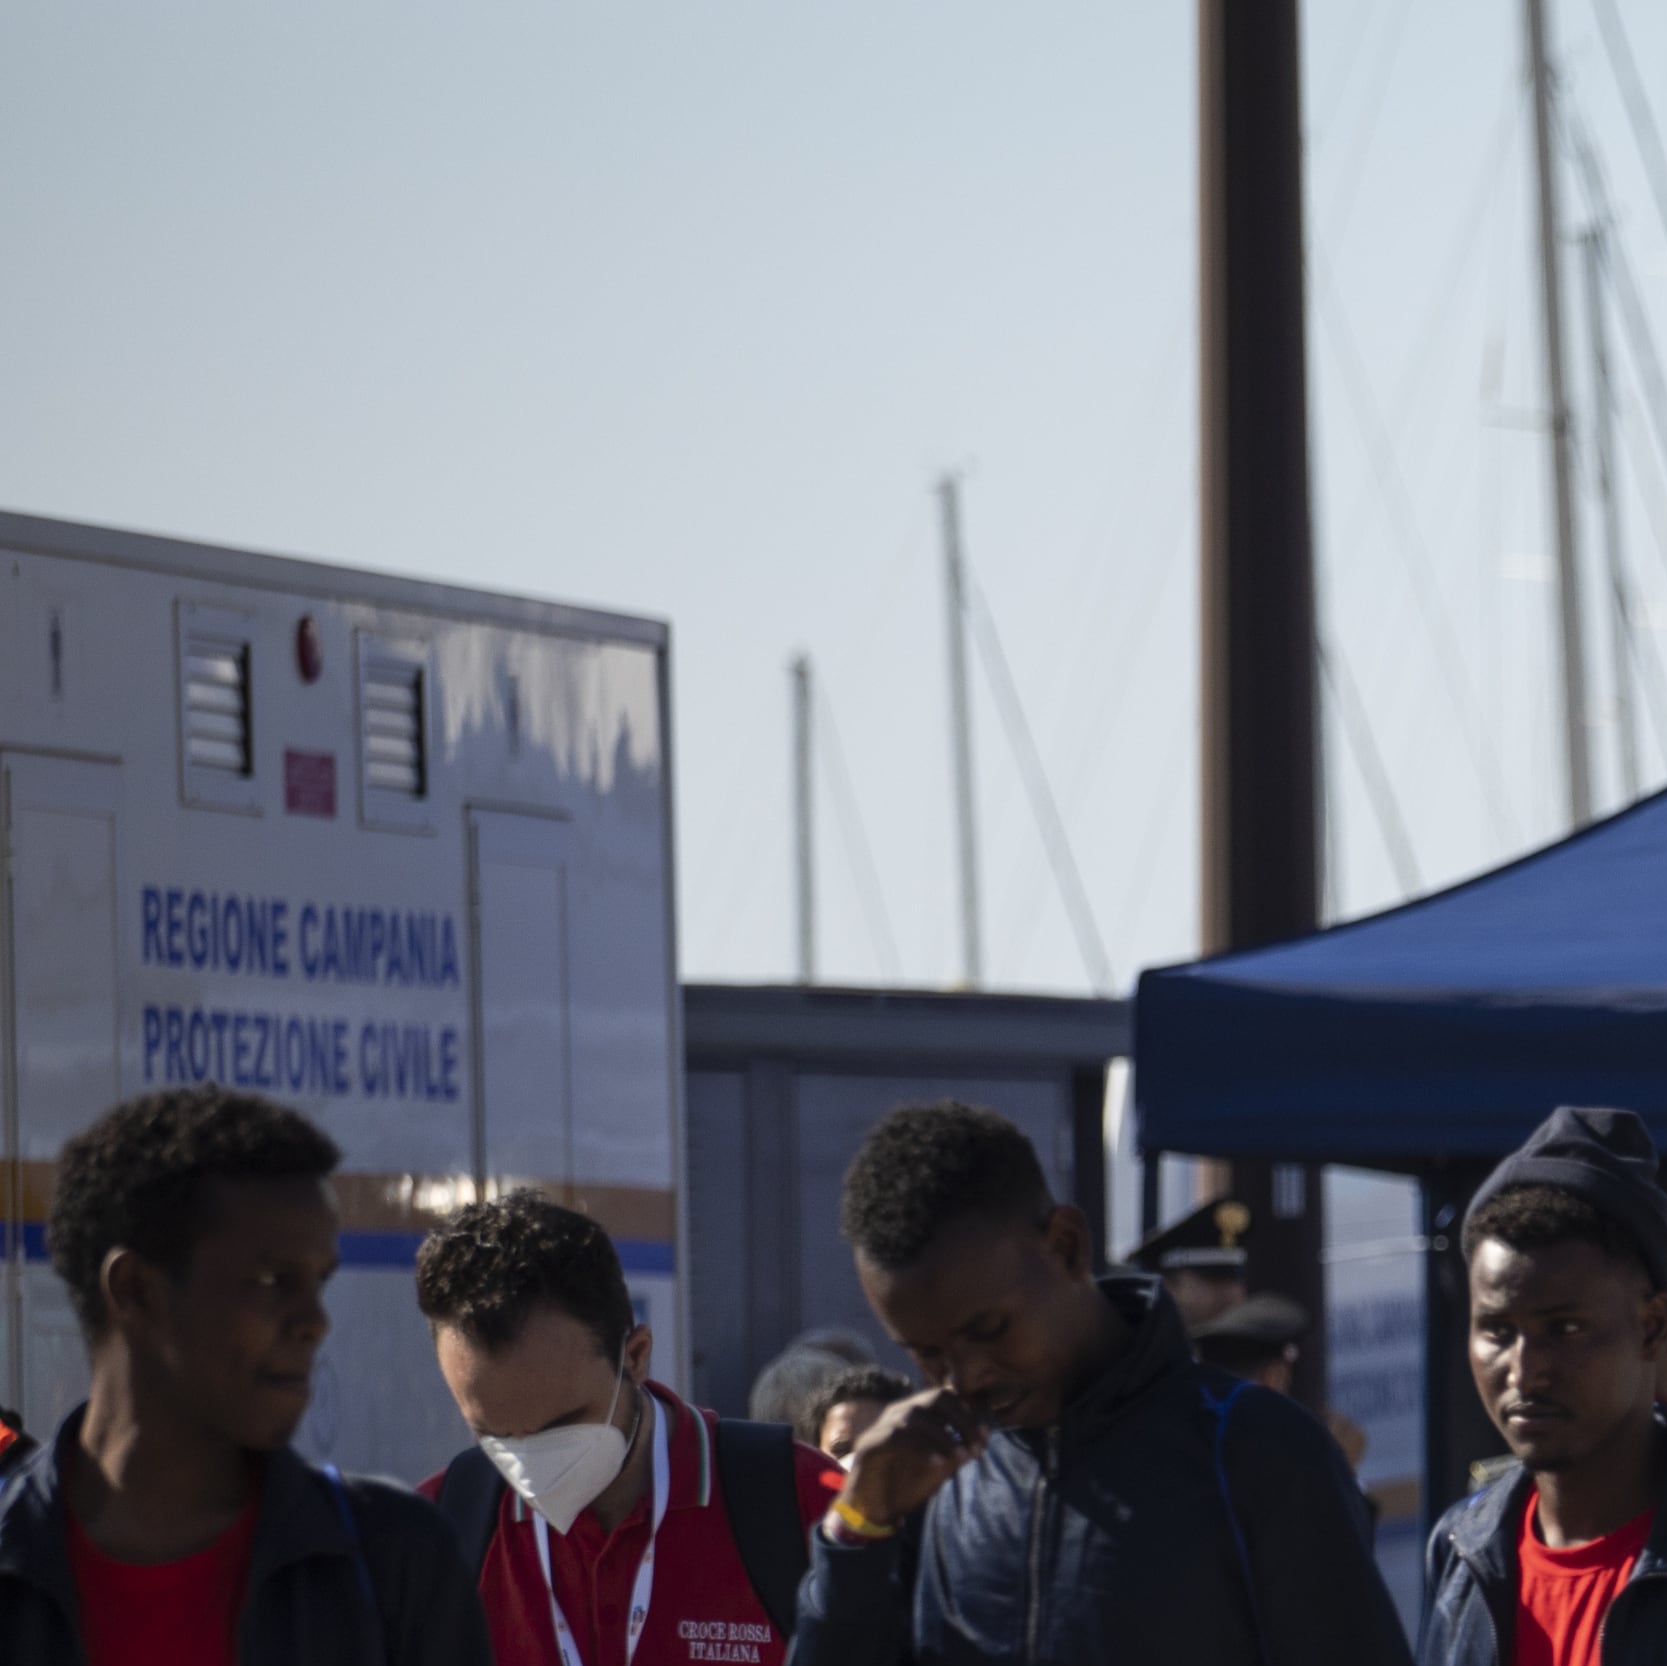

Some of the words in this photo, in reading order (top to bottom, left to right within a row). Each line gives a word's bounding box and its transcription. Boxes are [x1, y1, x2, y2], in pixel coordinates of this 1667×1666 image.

[142, 886, 289, 975] REGIONE
[300, 903, 459, 988] CAMPANIA
[142, 1004, 350, 1096] PROTEZIONE
[360, 1023, 459, 1099] CIVILE
[678, 1619, 726, 1640] CROCE
[727, 1621, 772, 1643] ROSSA
[689, 1640, 760, 1664] ITALIANA
